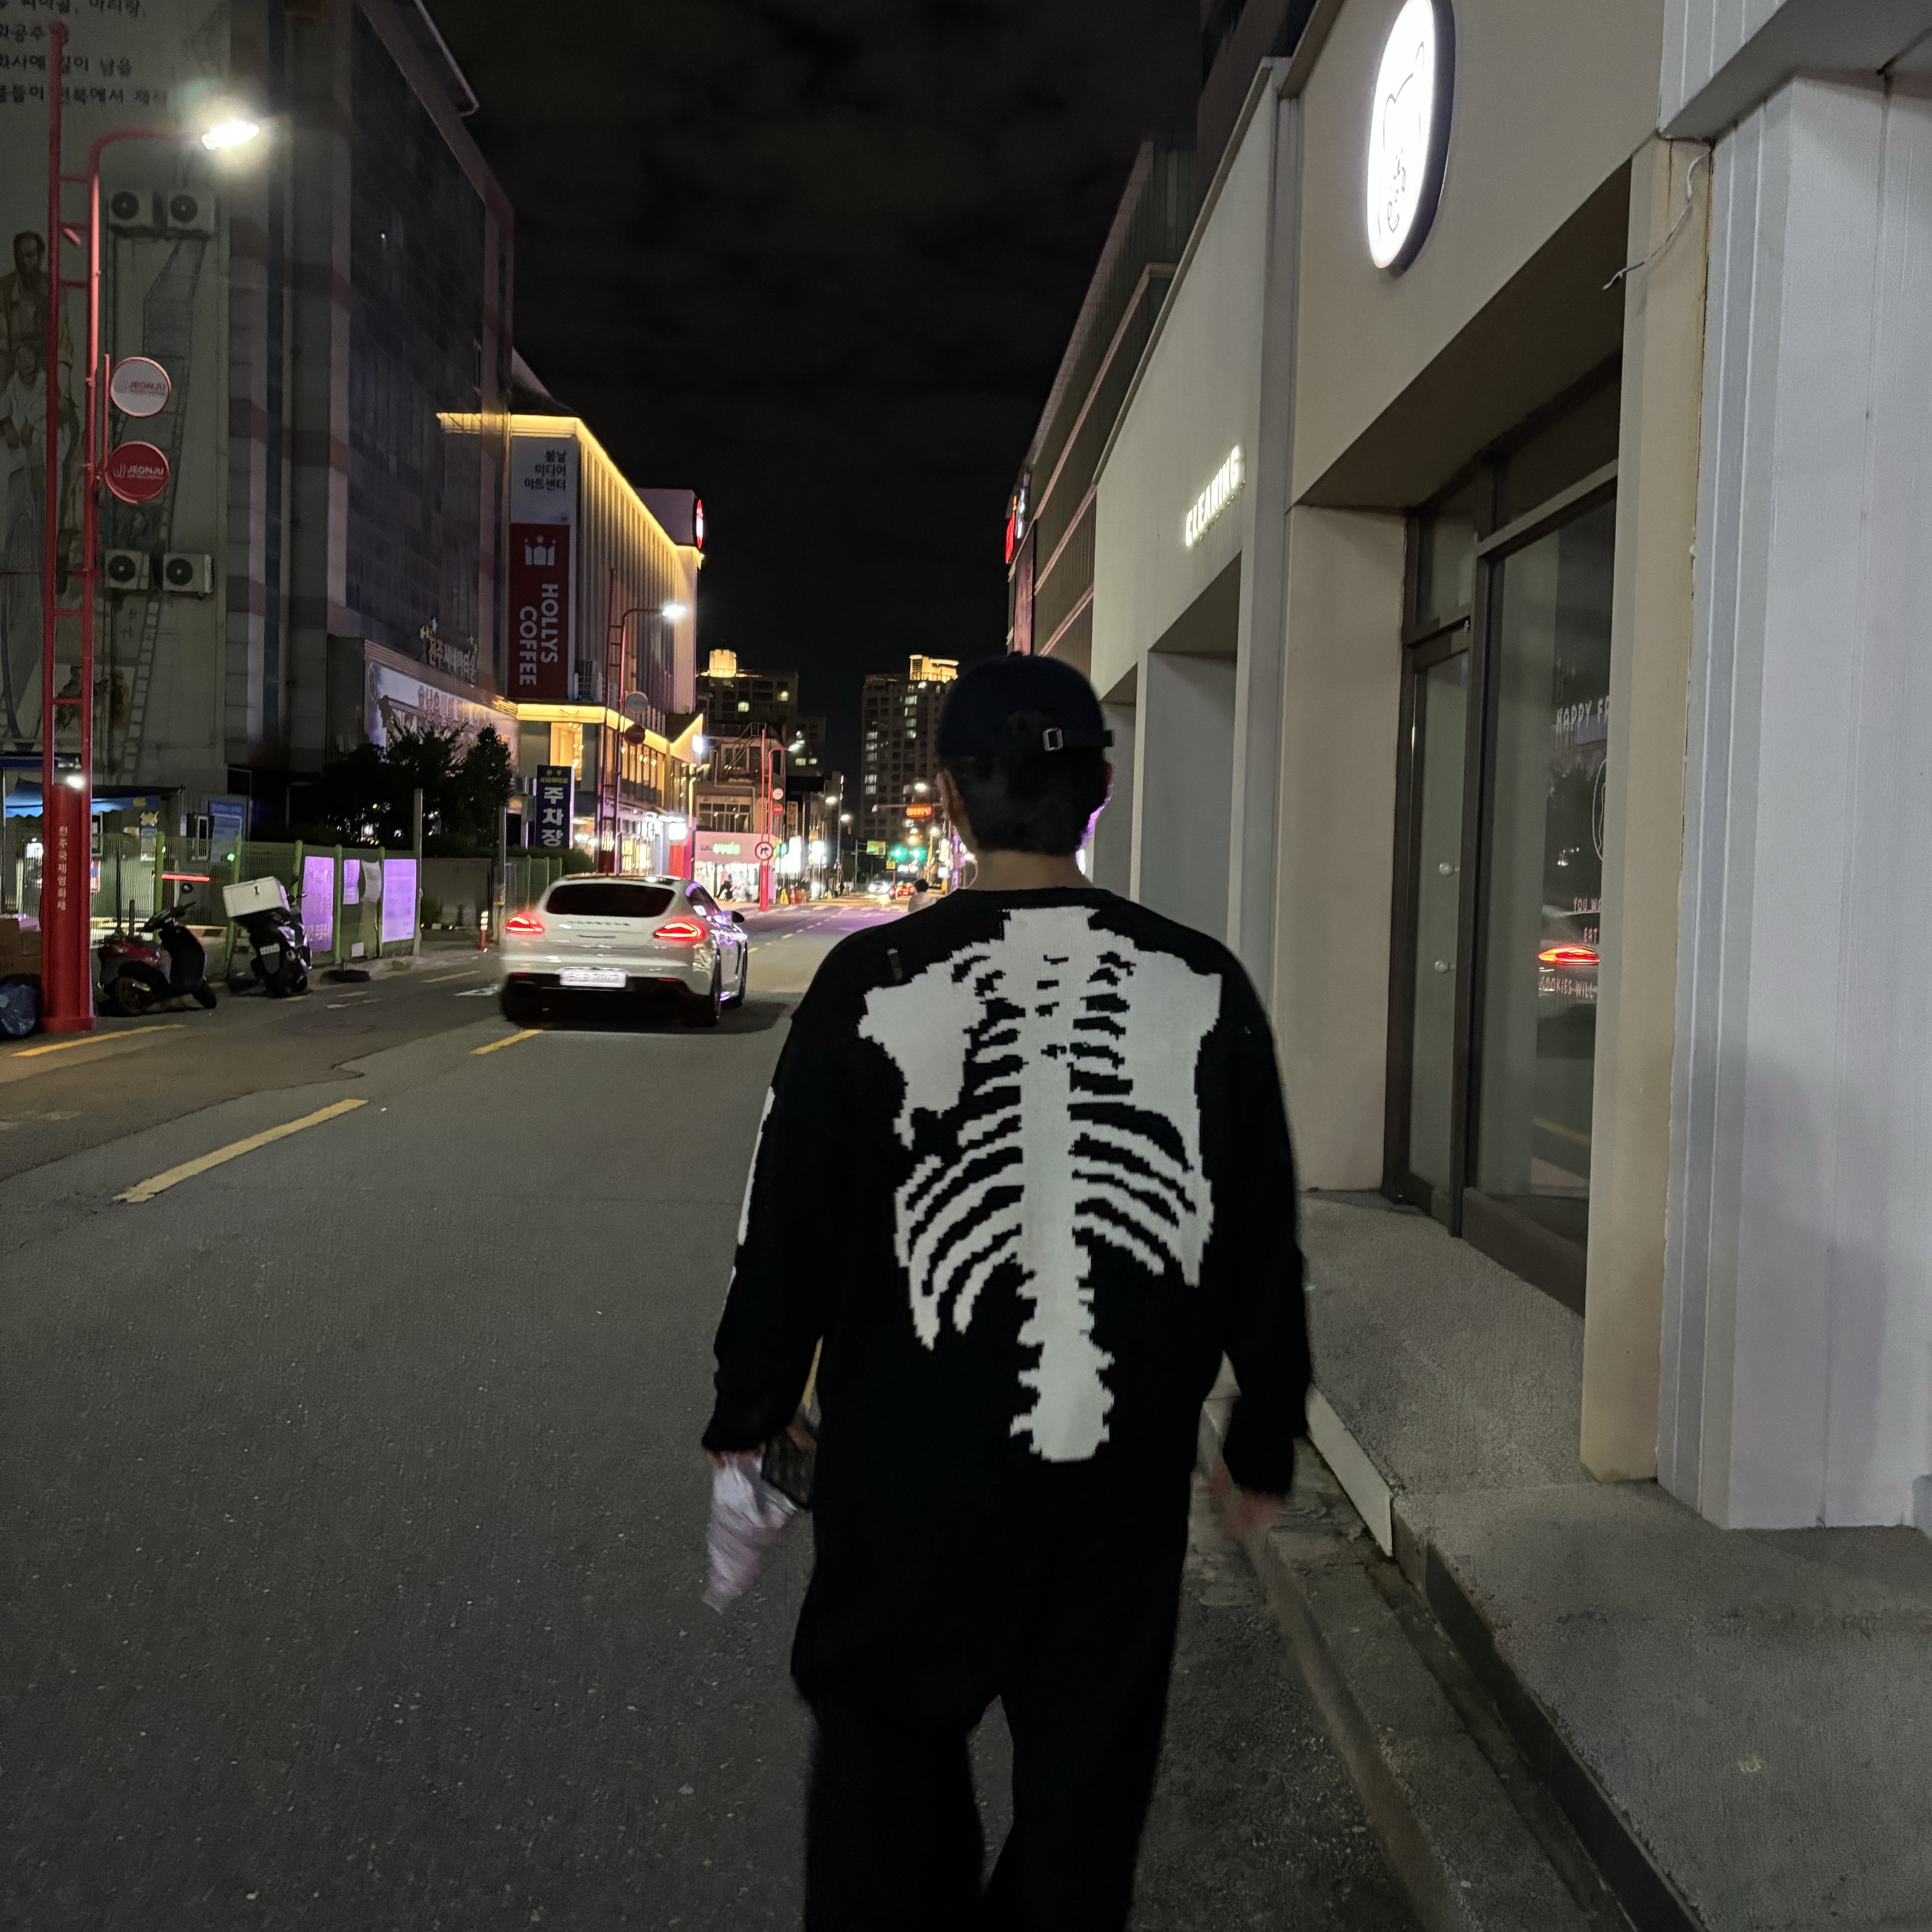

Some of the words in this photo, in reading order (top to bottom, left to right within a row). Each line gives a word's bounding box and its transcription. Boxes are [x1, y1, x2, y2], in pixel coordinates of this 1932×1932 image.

[128, 465, 165, 475] JEONJU
[524, 478, 566, 491] 아트센터
[535, 464, 566, 477] 미디어
[1185, 445, 1241, 547] CLEANING
[541, 584, 559, 664] HOLLYS
[519, 606, 538, 686] COFFEE
[1556, 700, 1592, 736] HAPPY
[541, 787, 564, 847] 주차장
[1573, 897, 1587, 912] YOU
